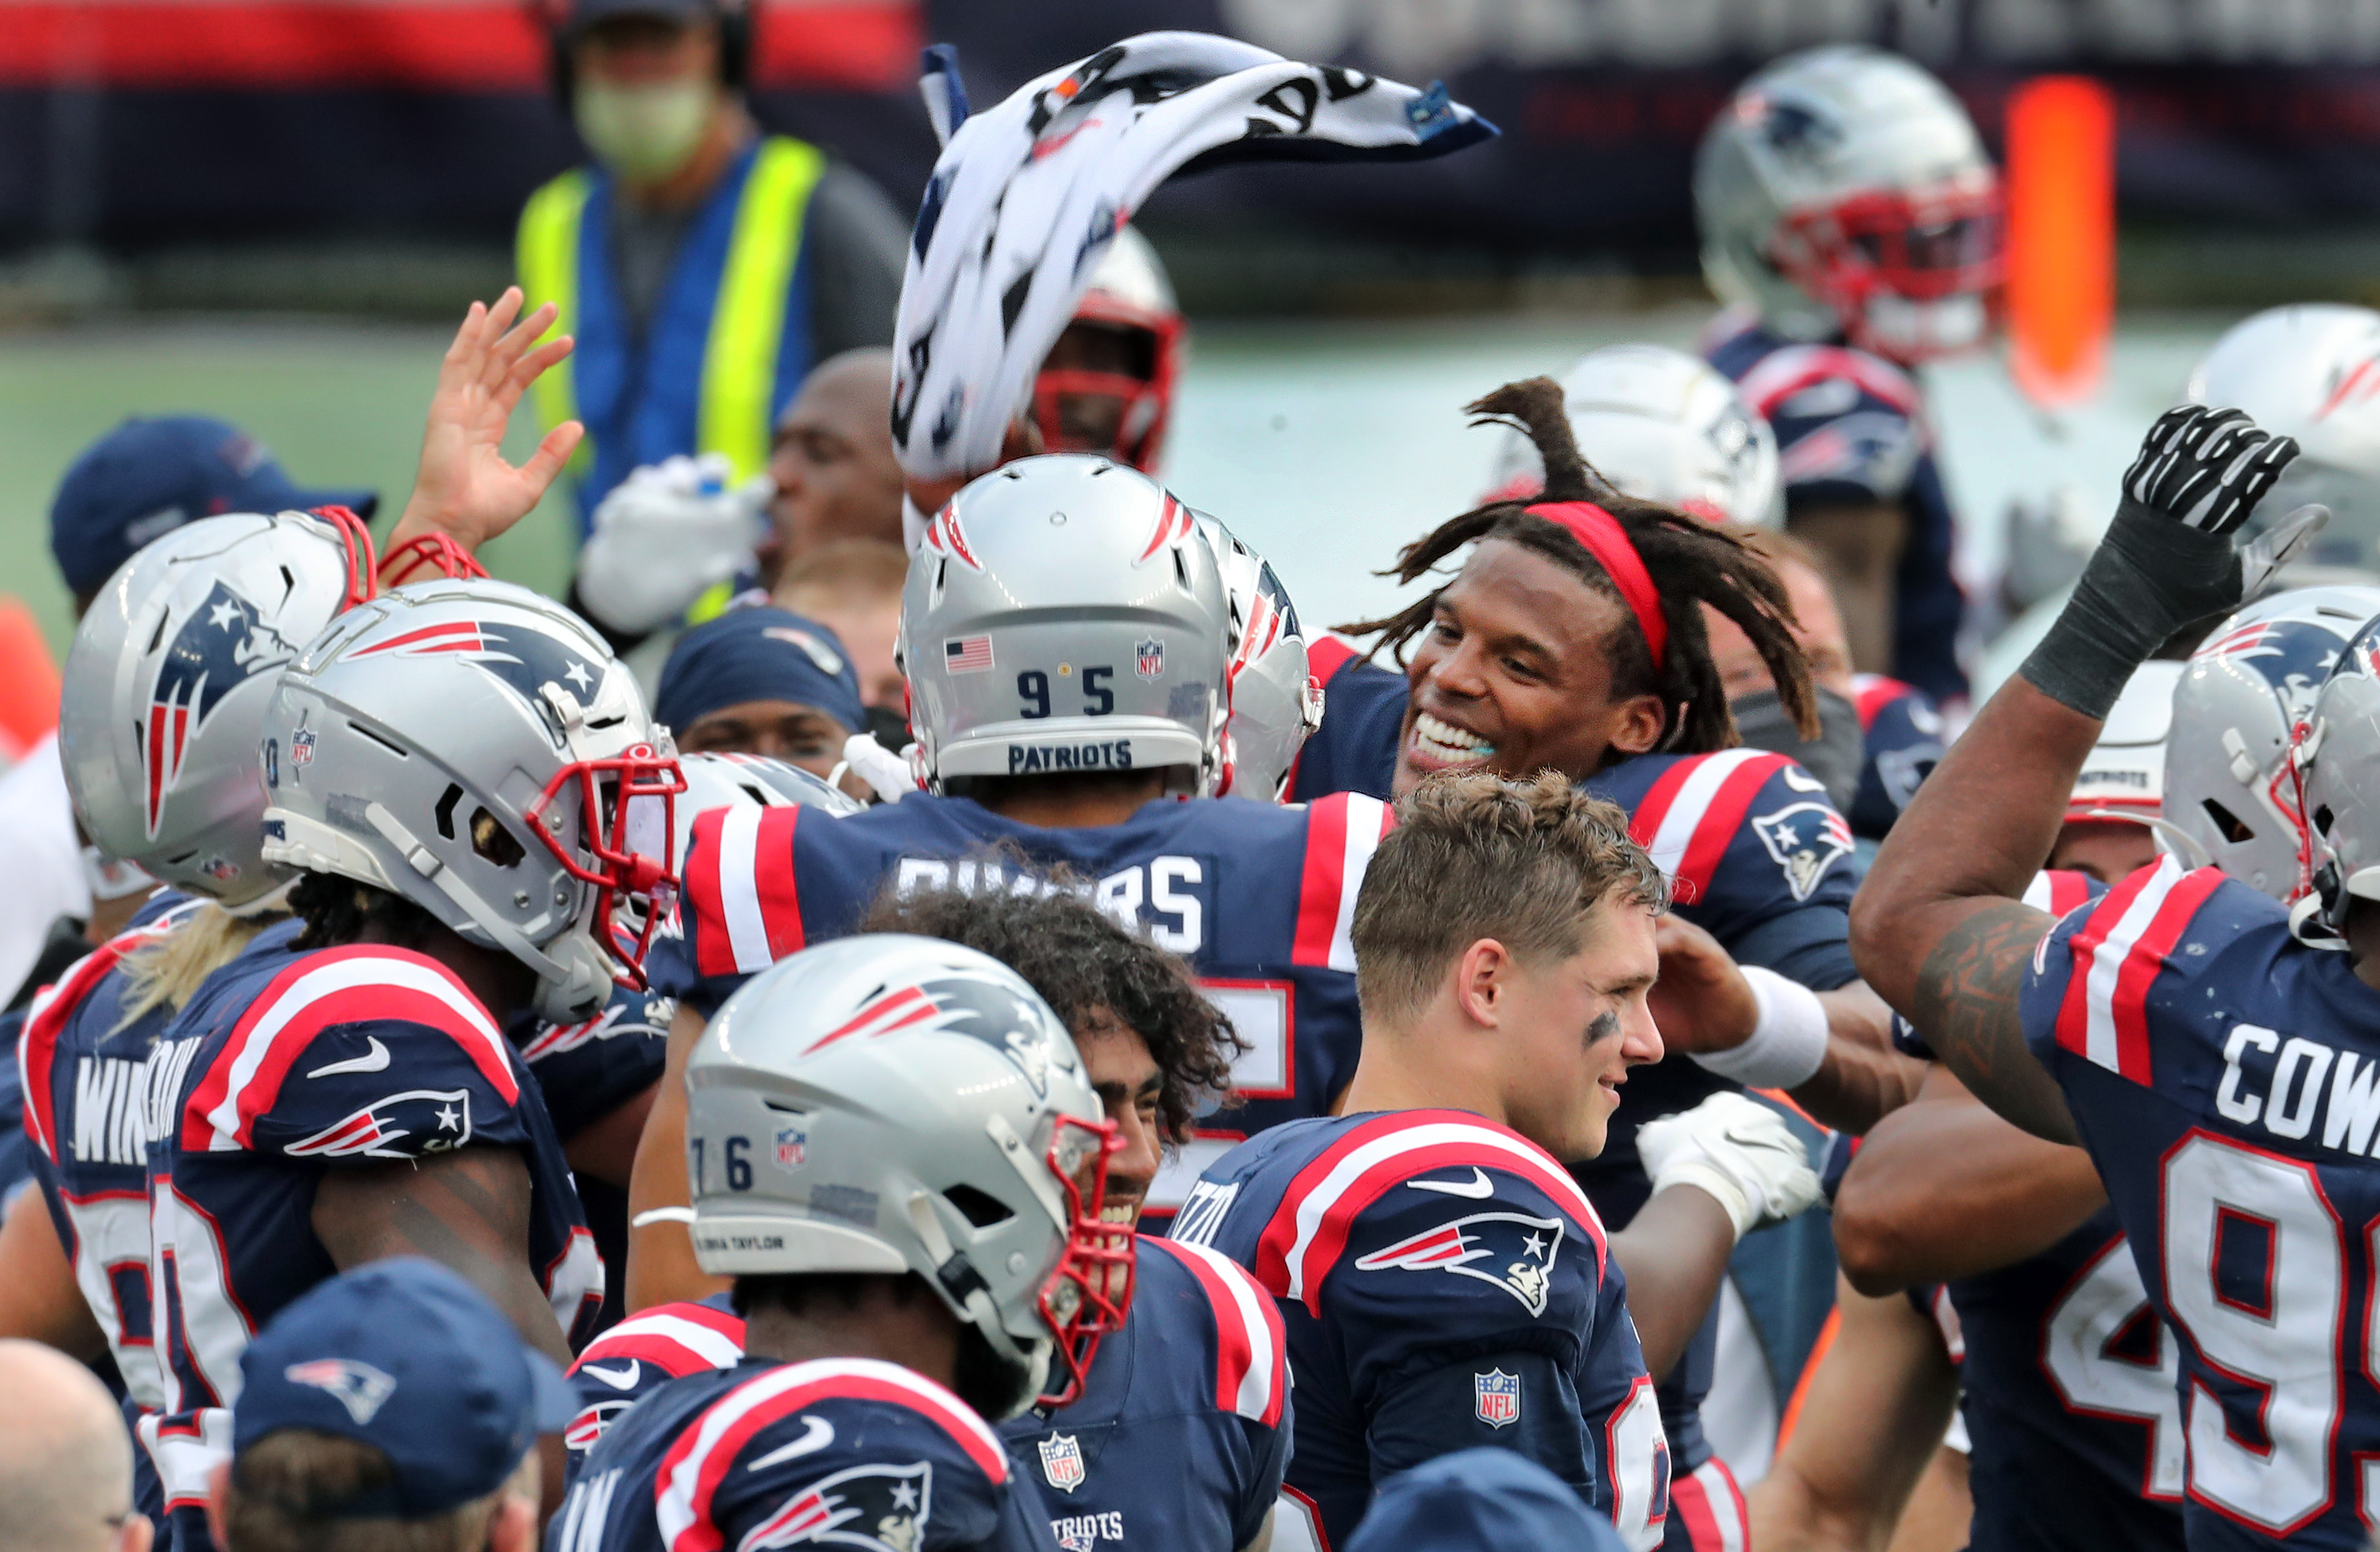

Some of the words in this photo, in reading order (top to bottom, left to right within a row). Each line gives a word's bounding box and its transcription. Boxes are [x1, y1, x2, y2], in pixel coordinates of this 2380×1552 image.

[1140, 656, 1162, 677] NFL
[292, 745, 311, 763] NFL
[1008, 739, 1132, 775] PATRIOTS
[731, 1236, 784, 1251] TAYLOR
[1481, 1394, 1514, 1420] NFL
[1051, 1459, 1080, 1481] NFL
[1049, 1510, 1124, 1540] TRIOTS
